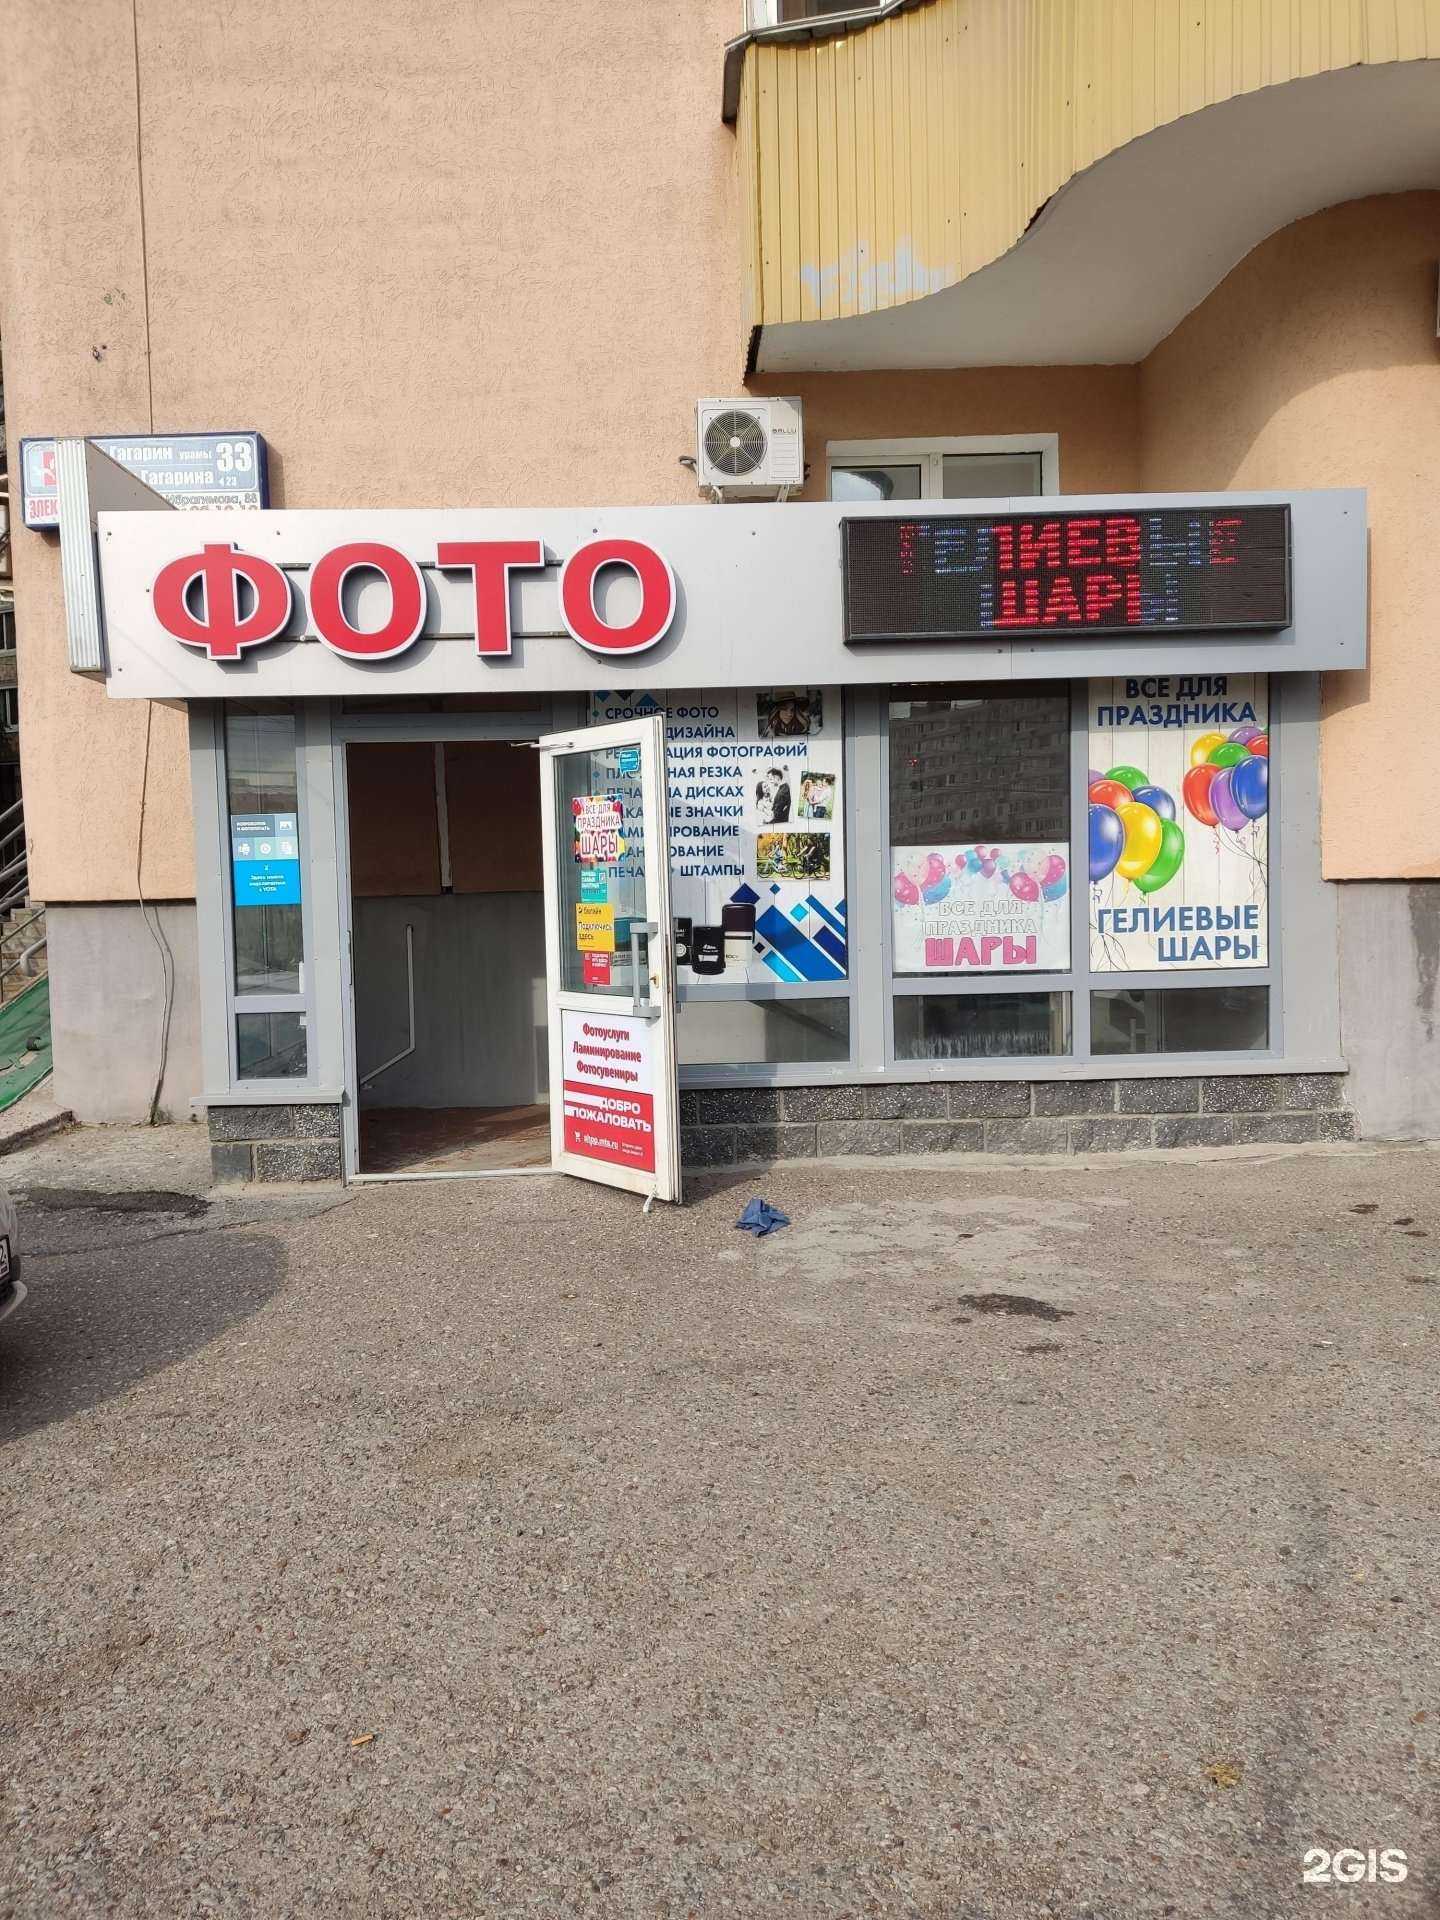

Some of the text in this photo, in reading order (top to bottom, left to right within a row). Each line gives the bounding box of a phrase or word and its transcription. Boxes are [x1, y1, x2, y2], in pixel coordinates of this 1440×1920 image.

[109, 445, 173, 461] Гагарин
[216, 441, 252, 472] 33
[140, 469, 214, 486] Гагарина
[152, 539, 677, 661] ФОТО
[979, 573, 1180, 629] ШАРЫ
[1125, 676, 1227, 701] ВСЕ ДЛЯ
[676, 705, 720, 719] ФОТО
[1097, 702, 1257, 729] ПРАЗДНИКА
[666, 724, 735, 740] ДИЗАЙНА
[706, 742, 808, 758] ФОТОГРАФИЙ
[699, 766, 743, 778] РЕЗКА
[685, 786, 744, 800] ДИСКАХ
[577, 815, 620, 829] ПРАЗДНИКА
[686, 805, 743, 819] ЗНАЧКИ
[581, 834, 618, 855] ШАРЫ
[680, 864, 745, 877] ШТАМПЫ
[938, 900, 1025, 917] ВСЕ ДЛЯ
[924, 918, 1040, 937] ПРАЗДНИКА
[1097, 904, 1259, 934] ГЕЛИЕВЫЕ
[925, 935, 1037, 966] ШАРЫ
[1158, 935, 1258, 962] ШАРЫ
[583, 1022, 630, 1042] Фотоуслуги
[572, 1041, 641, 1063] Ламинирование
[576, 1060, 639, 1083] Фотосувениры
[599, 1096, 641, 1115] ДОБРО
[572, 1105, 652, 1133] ПОЖАЛОВАТЬ
